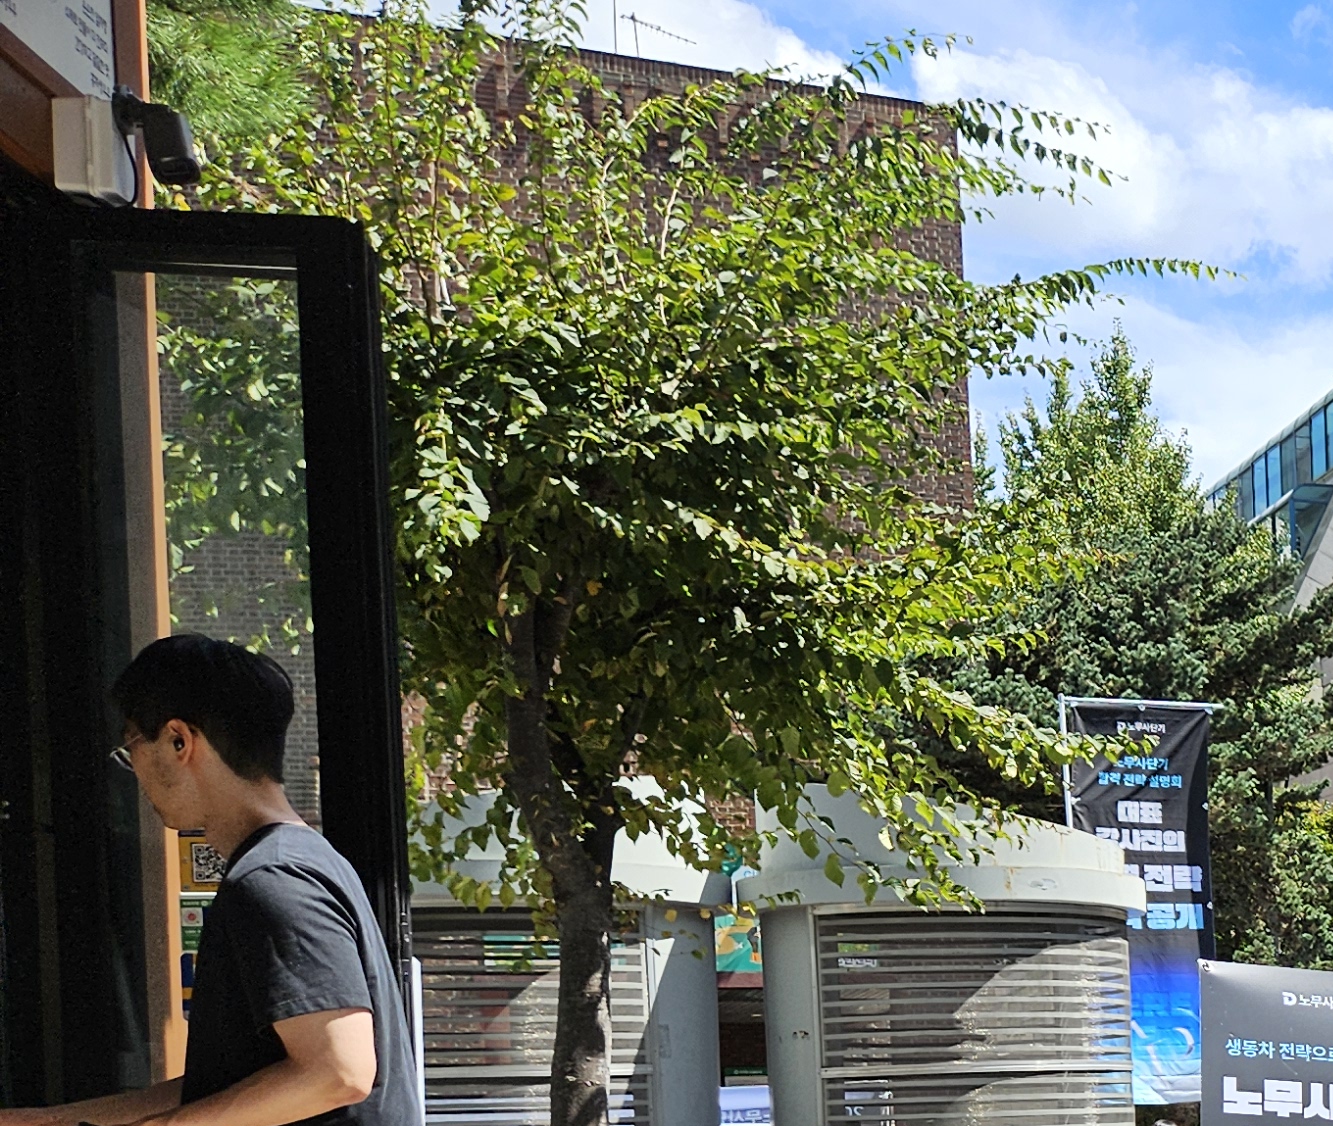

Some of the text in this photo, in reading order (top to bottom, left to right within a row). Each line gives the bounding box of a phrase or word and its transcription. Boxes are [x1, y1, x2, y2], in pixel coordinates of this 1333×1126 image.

[1143, 864, 1203, 892] 전략
[1146, 903, 1204, 930] 공개
[1225, 1038, 1275, 1059] 생동차
